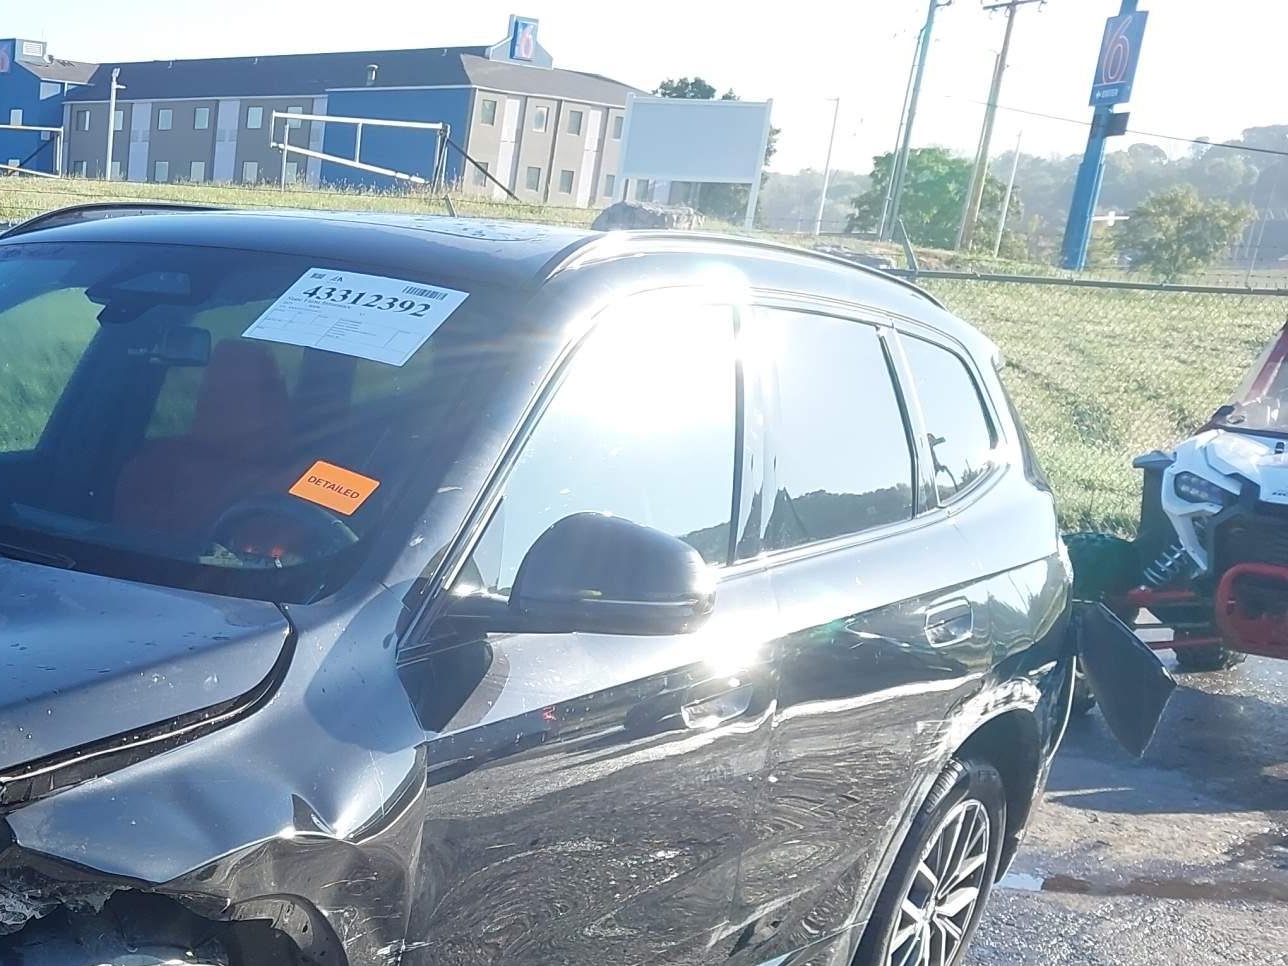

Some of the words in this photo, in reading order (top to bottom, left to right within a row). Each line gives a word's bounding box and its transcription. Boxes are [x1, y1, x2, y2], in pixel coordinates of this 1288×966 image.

[1103, 15, 1132, 84] 6
[302, 285, 431, 318] 43312392
[307, 475, 360, 499] DETAILED
